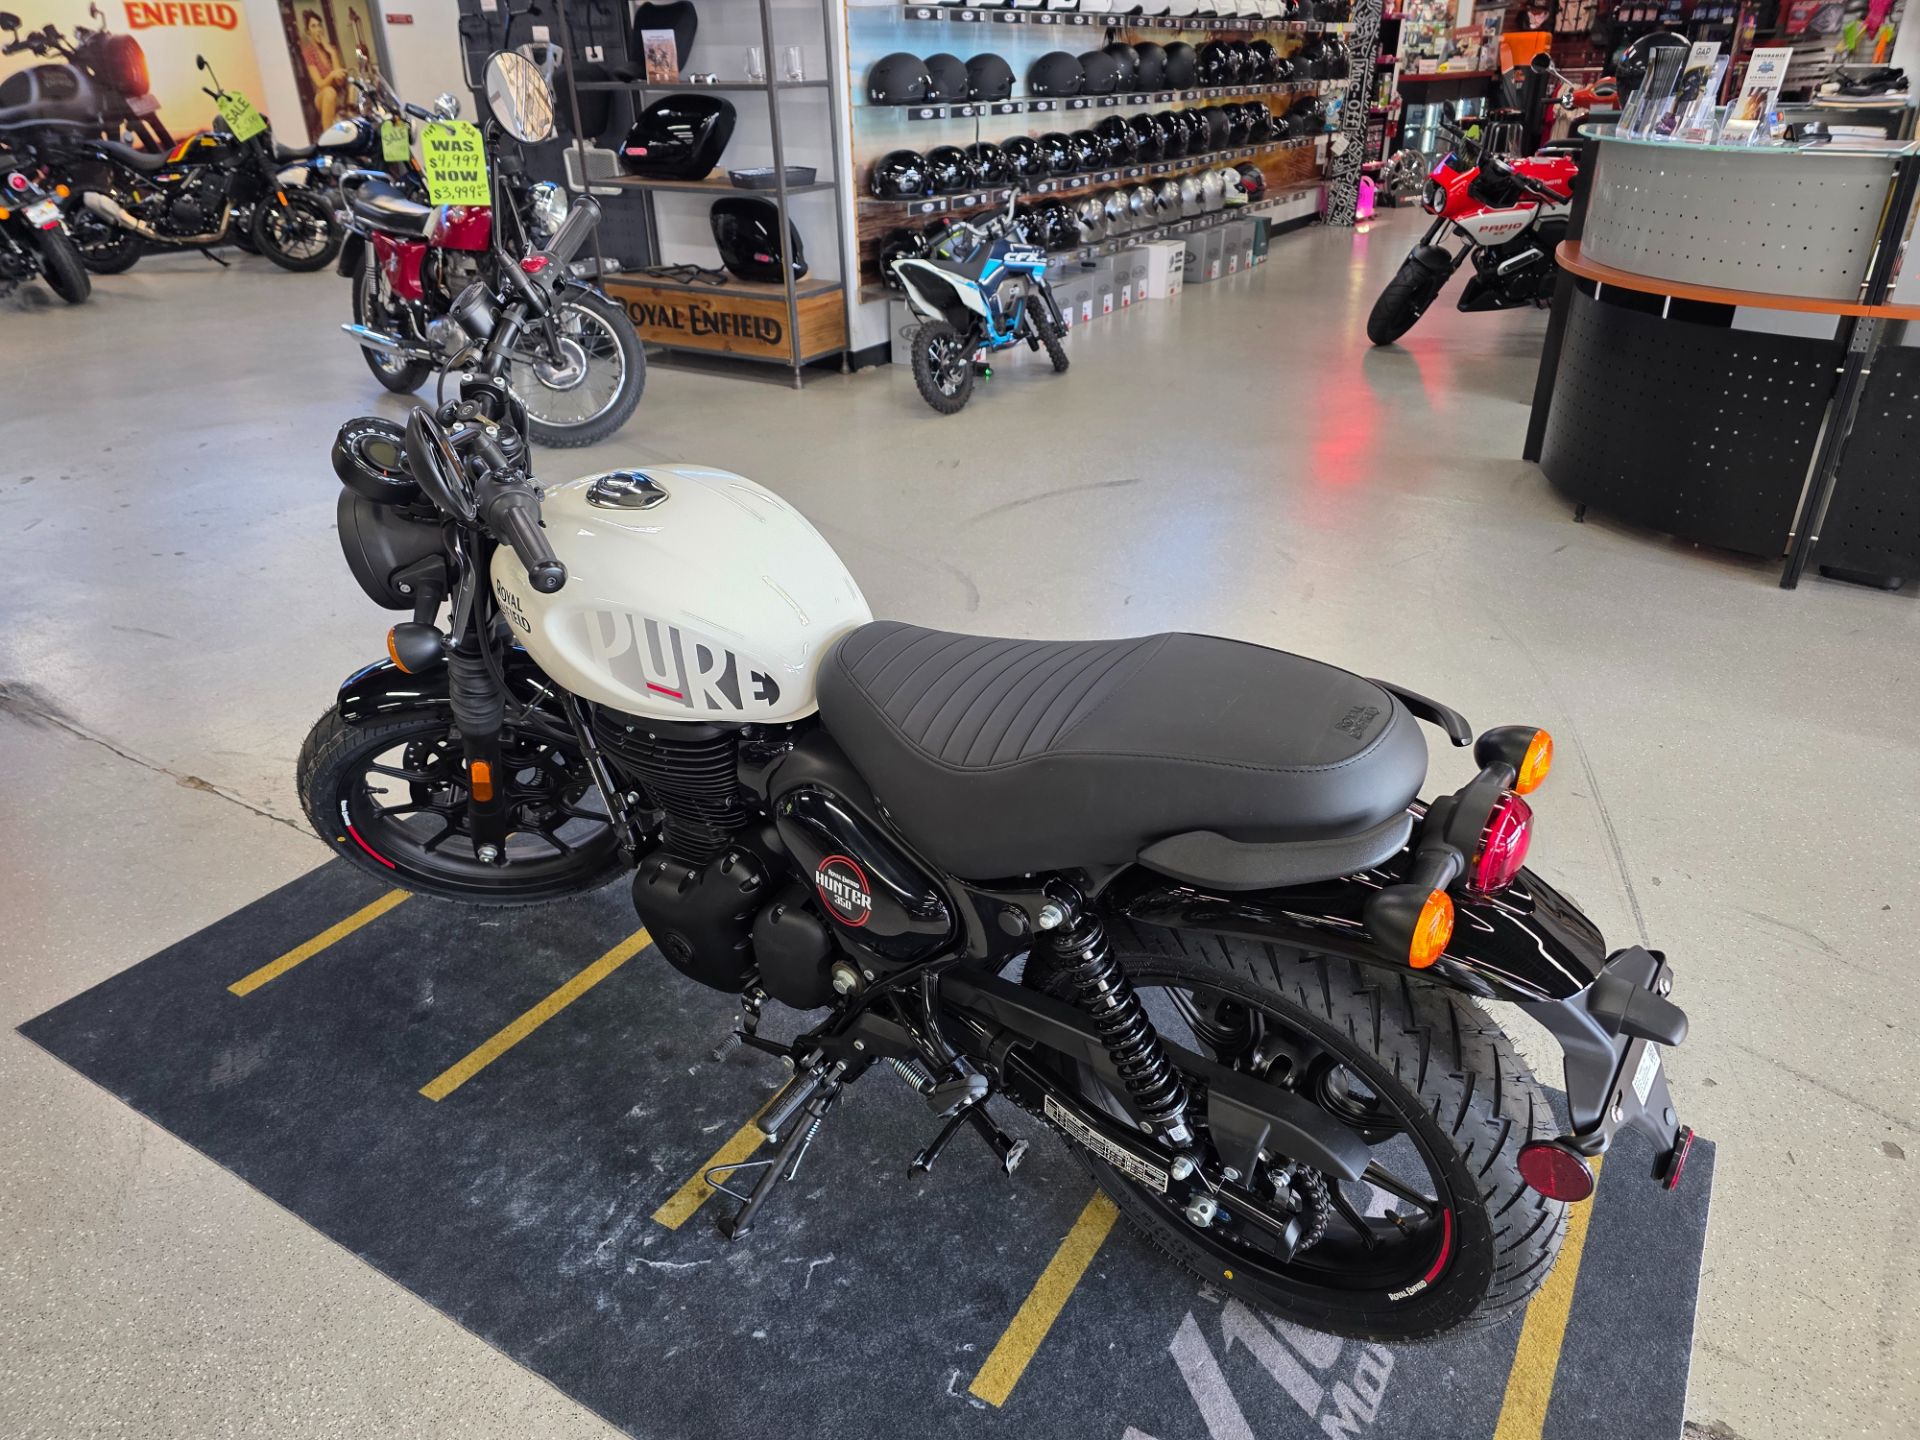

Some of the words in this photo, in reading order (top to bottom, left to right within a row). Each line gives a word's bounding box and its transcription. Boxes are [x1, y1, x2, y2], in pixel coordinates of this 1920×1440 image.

[123, 1, 239, 31] ENFIELD
[1696, 47, 1712, 55] GAP
[224, 97, 250, 125] SALE
[431, 140, 475, 152] WAS
[429, 154, 480, 169] $4,999
[434, 170, 478, 182] NOW
[1479, 222, 1523, 232] PAPIO
[688, 303, 783, 345] ENFIELD
[496, 579, 522, 612] ROYAL
[584, 609, 778, 710] PURE
[815, 870, 872, 911] HUNTER
[834, 894, 852, 911] 350
[1388, 1290, 1408, 1301] ROYAL
[1405, 1280, 1427, 1296] ENFIELD
